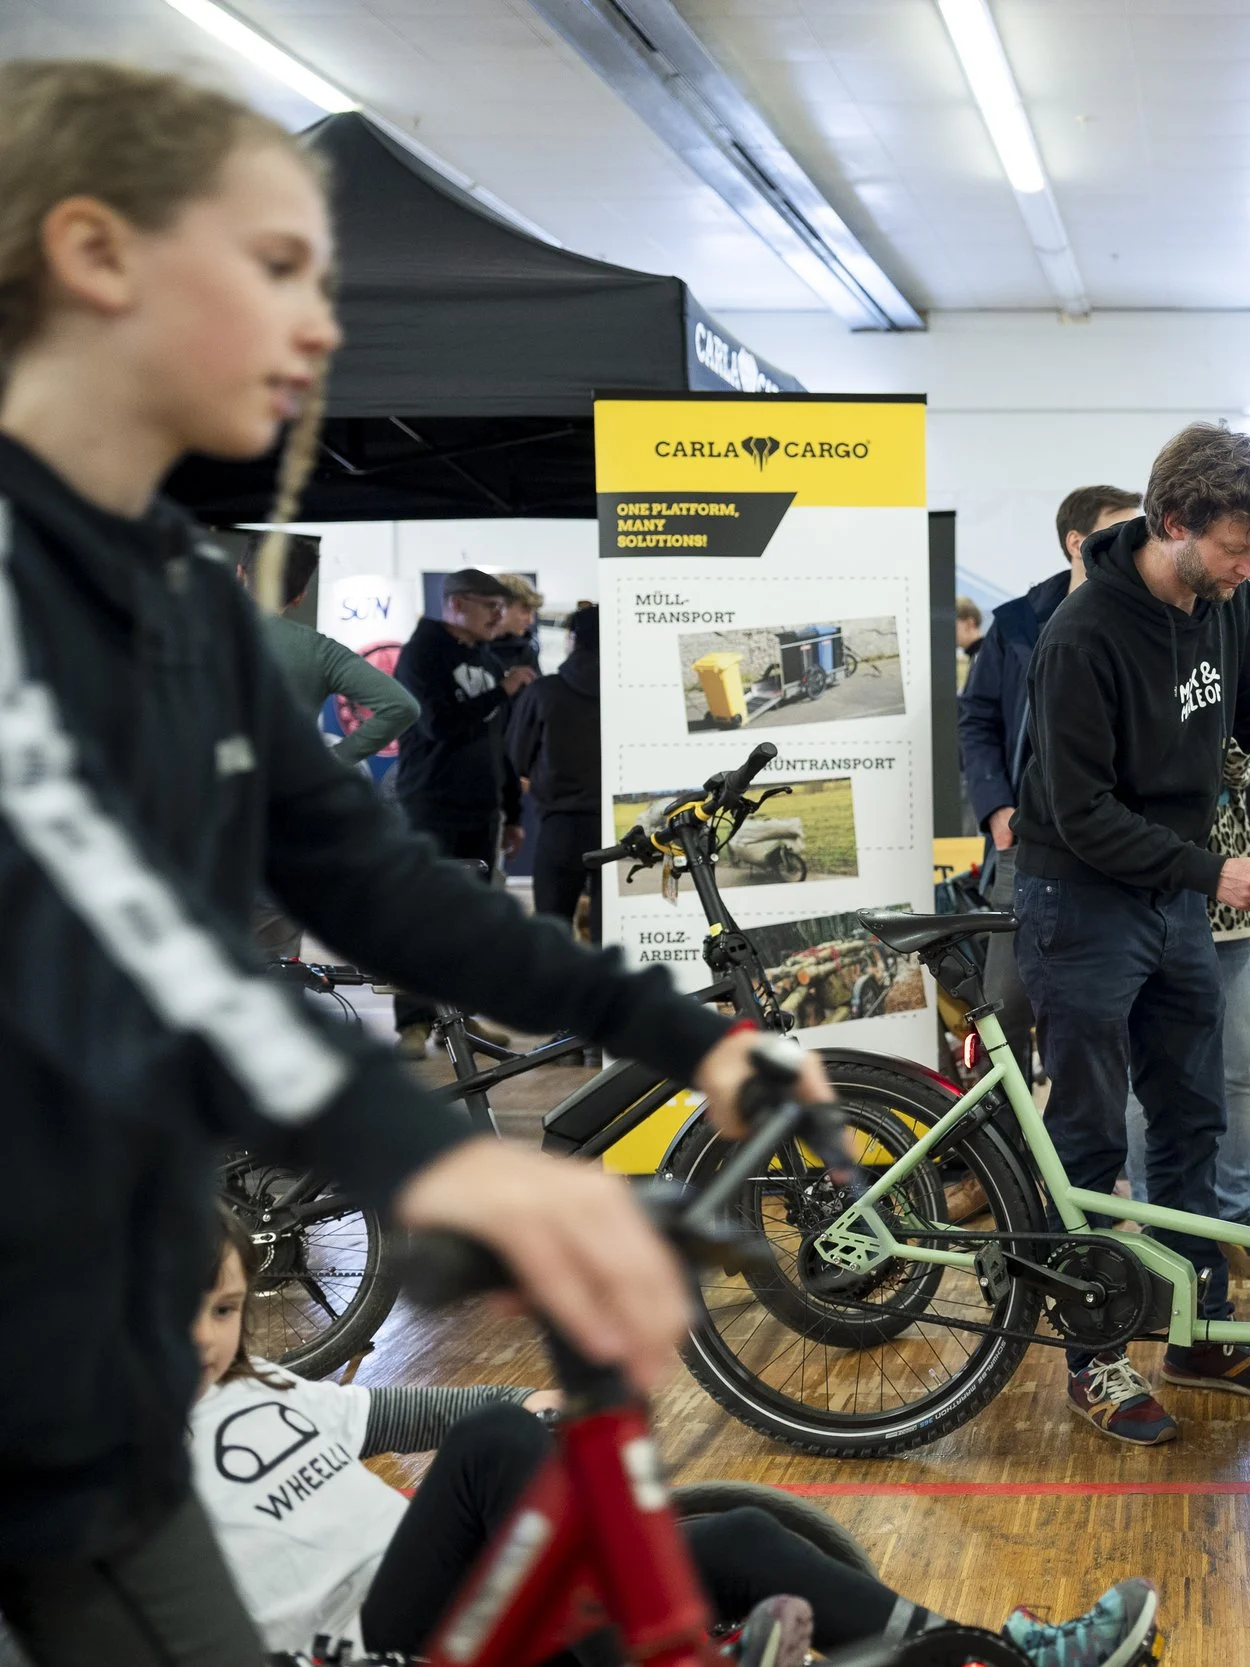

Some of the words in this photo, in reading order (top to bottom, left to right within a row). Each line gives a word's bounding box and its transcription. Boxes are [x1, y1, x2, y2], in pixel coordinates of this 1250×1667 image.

[654, 440, 739, 459] CARLA
[784, 441, 869, 459] CARGO
[616, 503, 650, 517] ONE
[651, 502, 740, 518] PLATFORM,
[617, 519, 666, 532] MANY
[616, 535, 708, 548] SOLUTIONS!
[635, 591, 690, 606] MÜLL-
[635, 612, 735, 624] TRANSPORT
[1200, 661, 1221, 684] &
[763, 756, 896, 772] RÜNTRANSPORT
[640, 931, 691, 944] HOLZ-
[640, 949, 700, 961] ARBEIT
[934, 1384, 977, 1420] MARATHON
